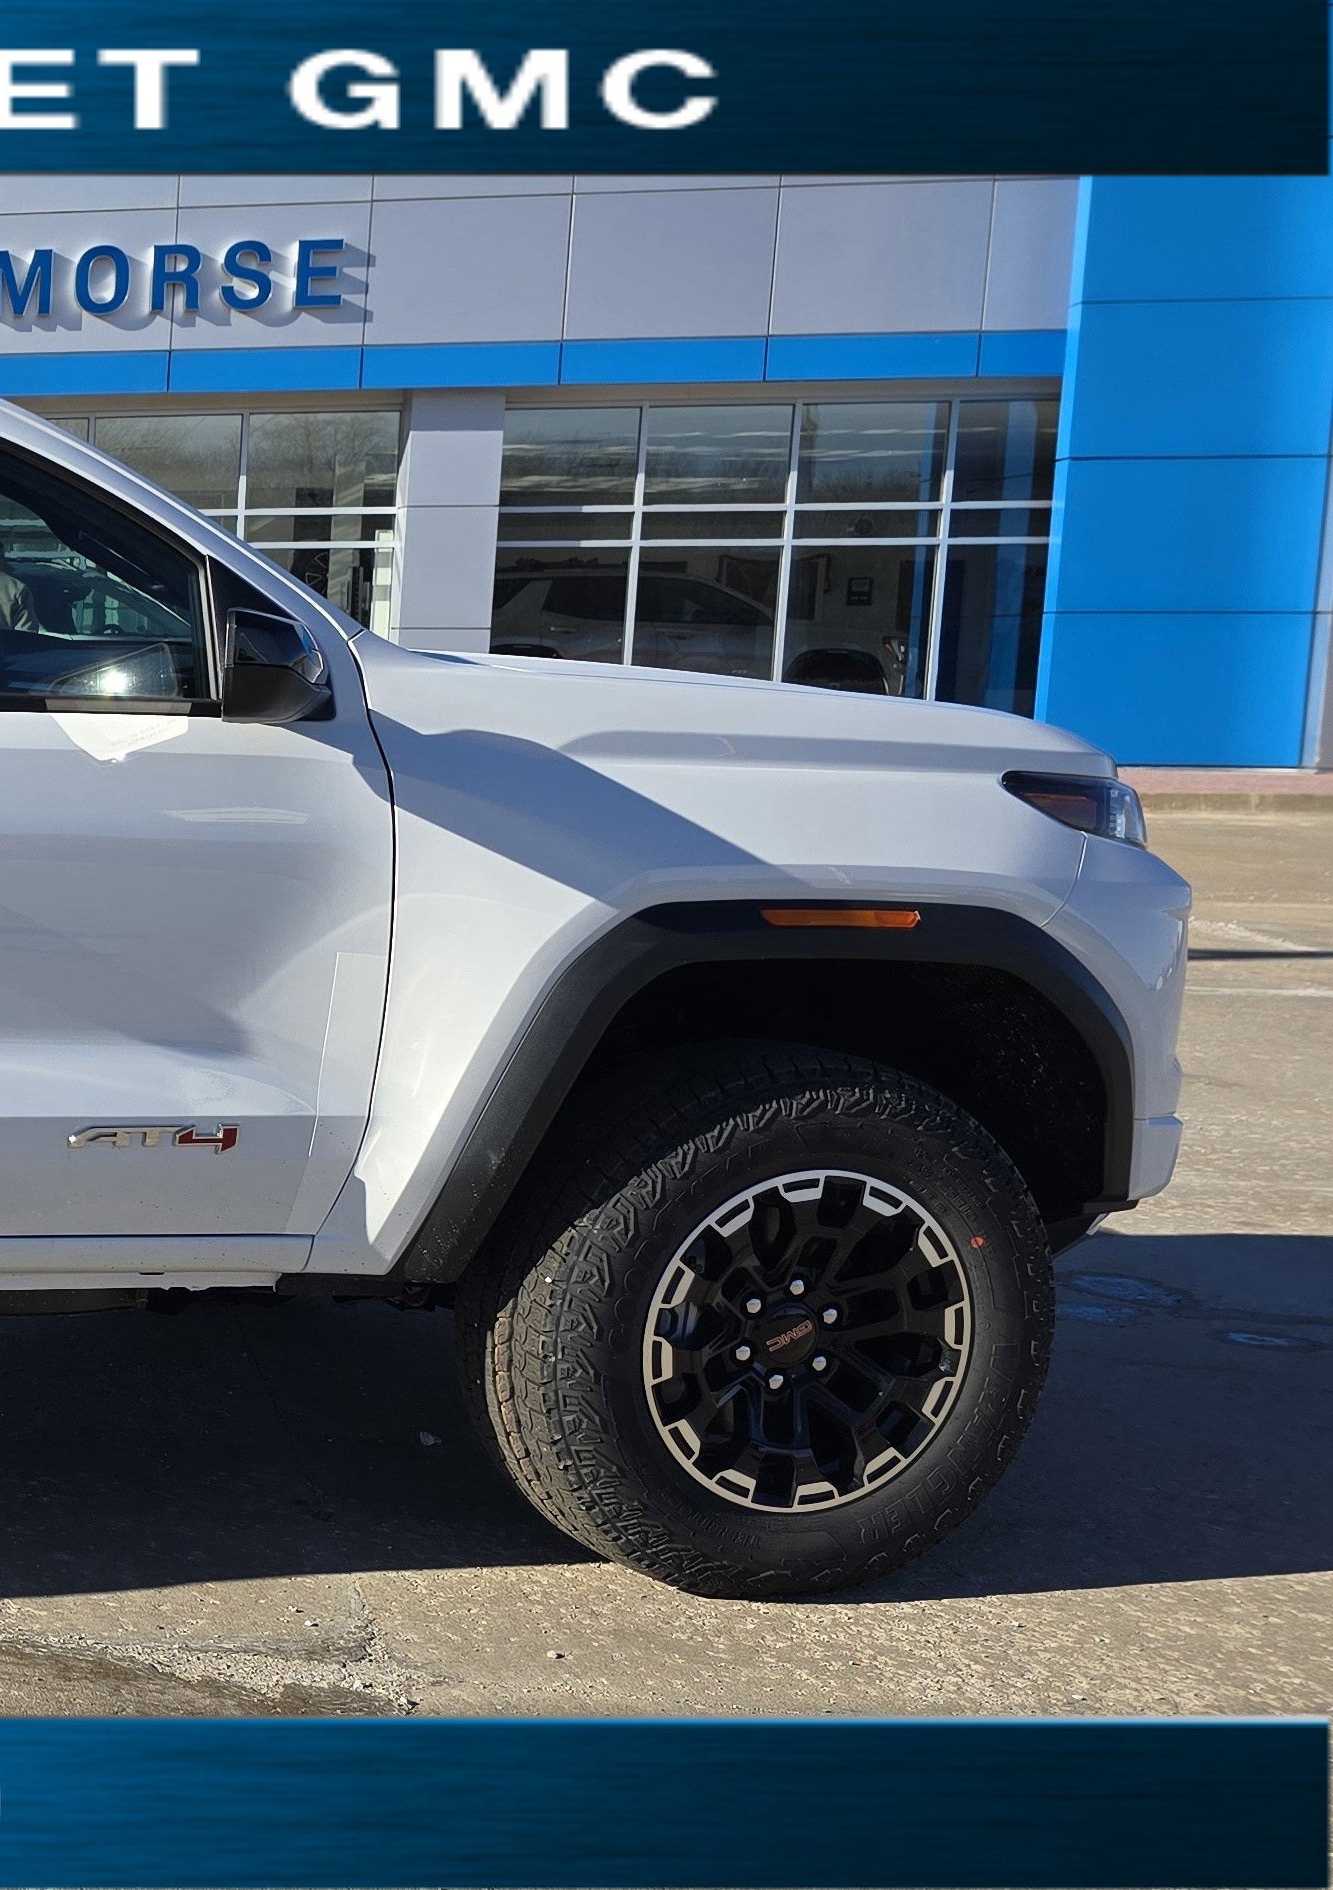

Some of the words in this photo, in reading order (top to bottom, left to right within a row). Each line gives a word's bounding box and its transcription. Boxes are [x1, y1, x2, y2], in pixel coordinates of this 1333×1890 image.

[67, 1124, 240, 1155] AT4
[766, 1319, 813, 1353] GMC
[856, 1342, 1021, 1544] WRANGLER
